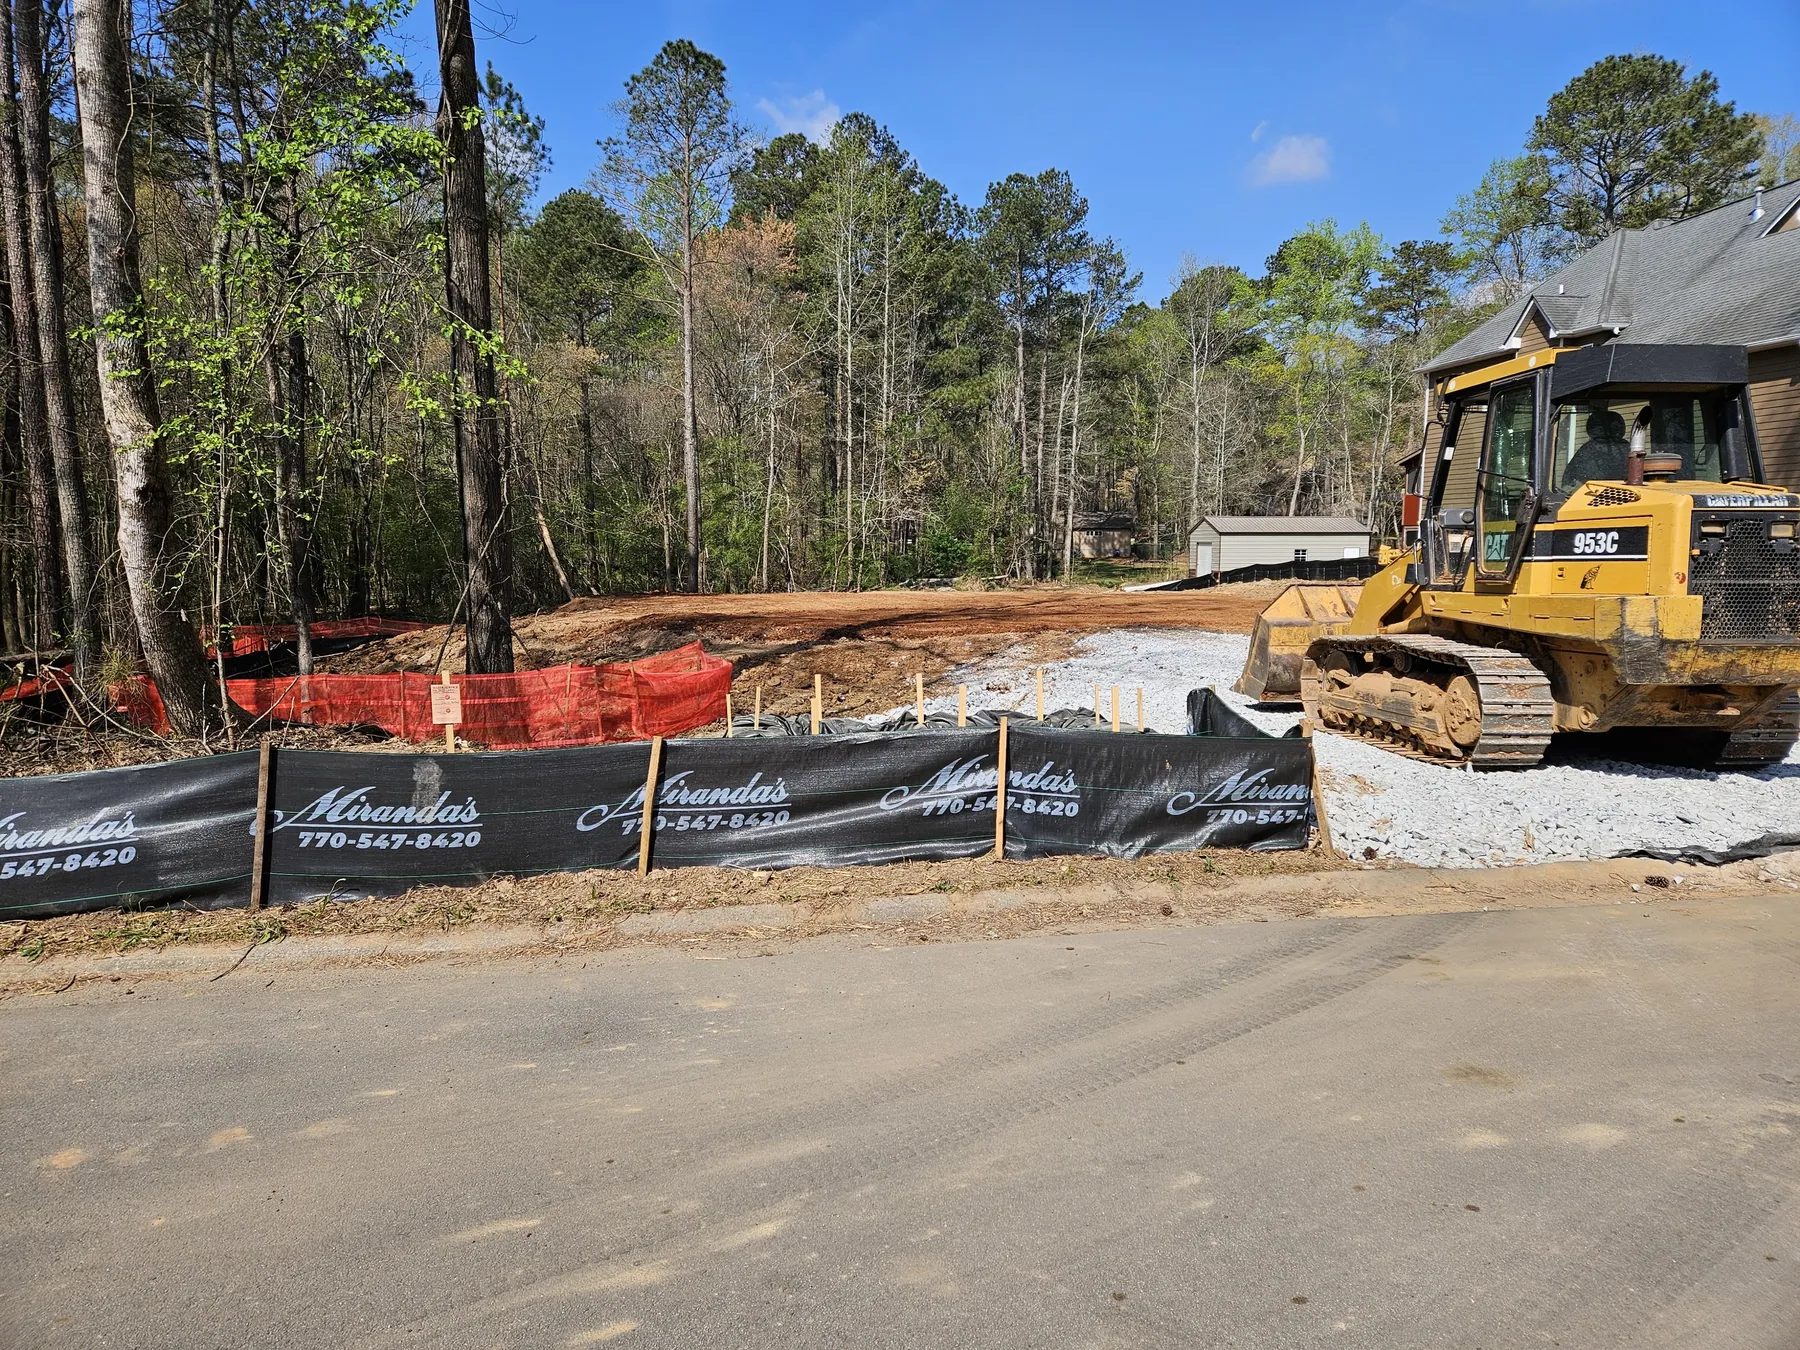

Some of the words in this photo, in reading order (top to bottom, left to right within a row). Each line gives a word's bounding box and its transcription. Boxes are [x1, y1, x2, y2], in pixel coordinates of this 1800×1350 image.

[1484, 534, 1509, 560] CAT
[1573, 531, 1619, 554] 953C
[250, 786, 481, 836] Miranda's
[1206, 807, 1309, 825] 770-547-
[0, 807, 136, 851] iranda's
[298, 831, 482, 850] 770-547-8420
